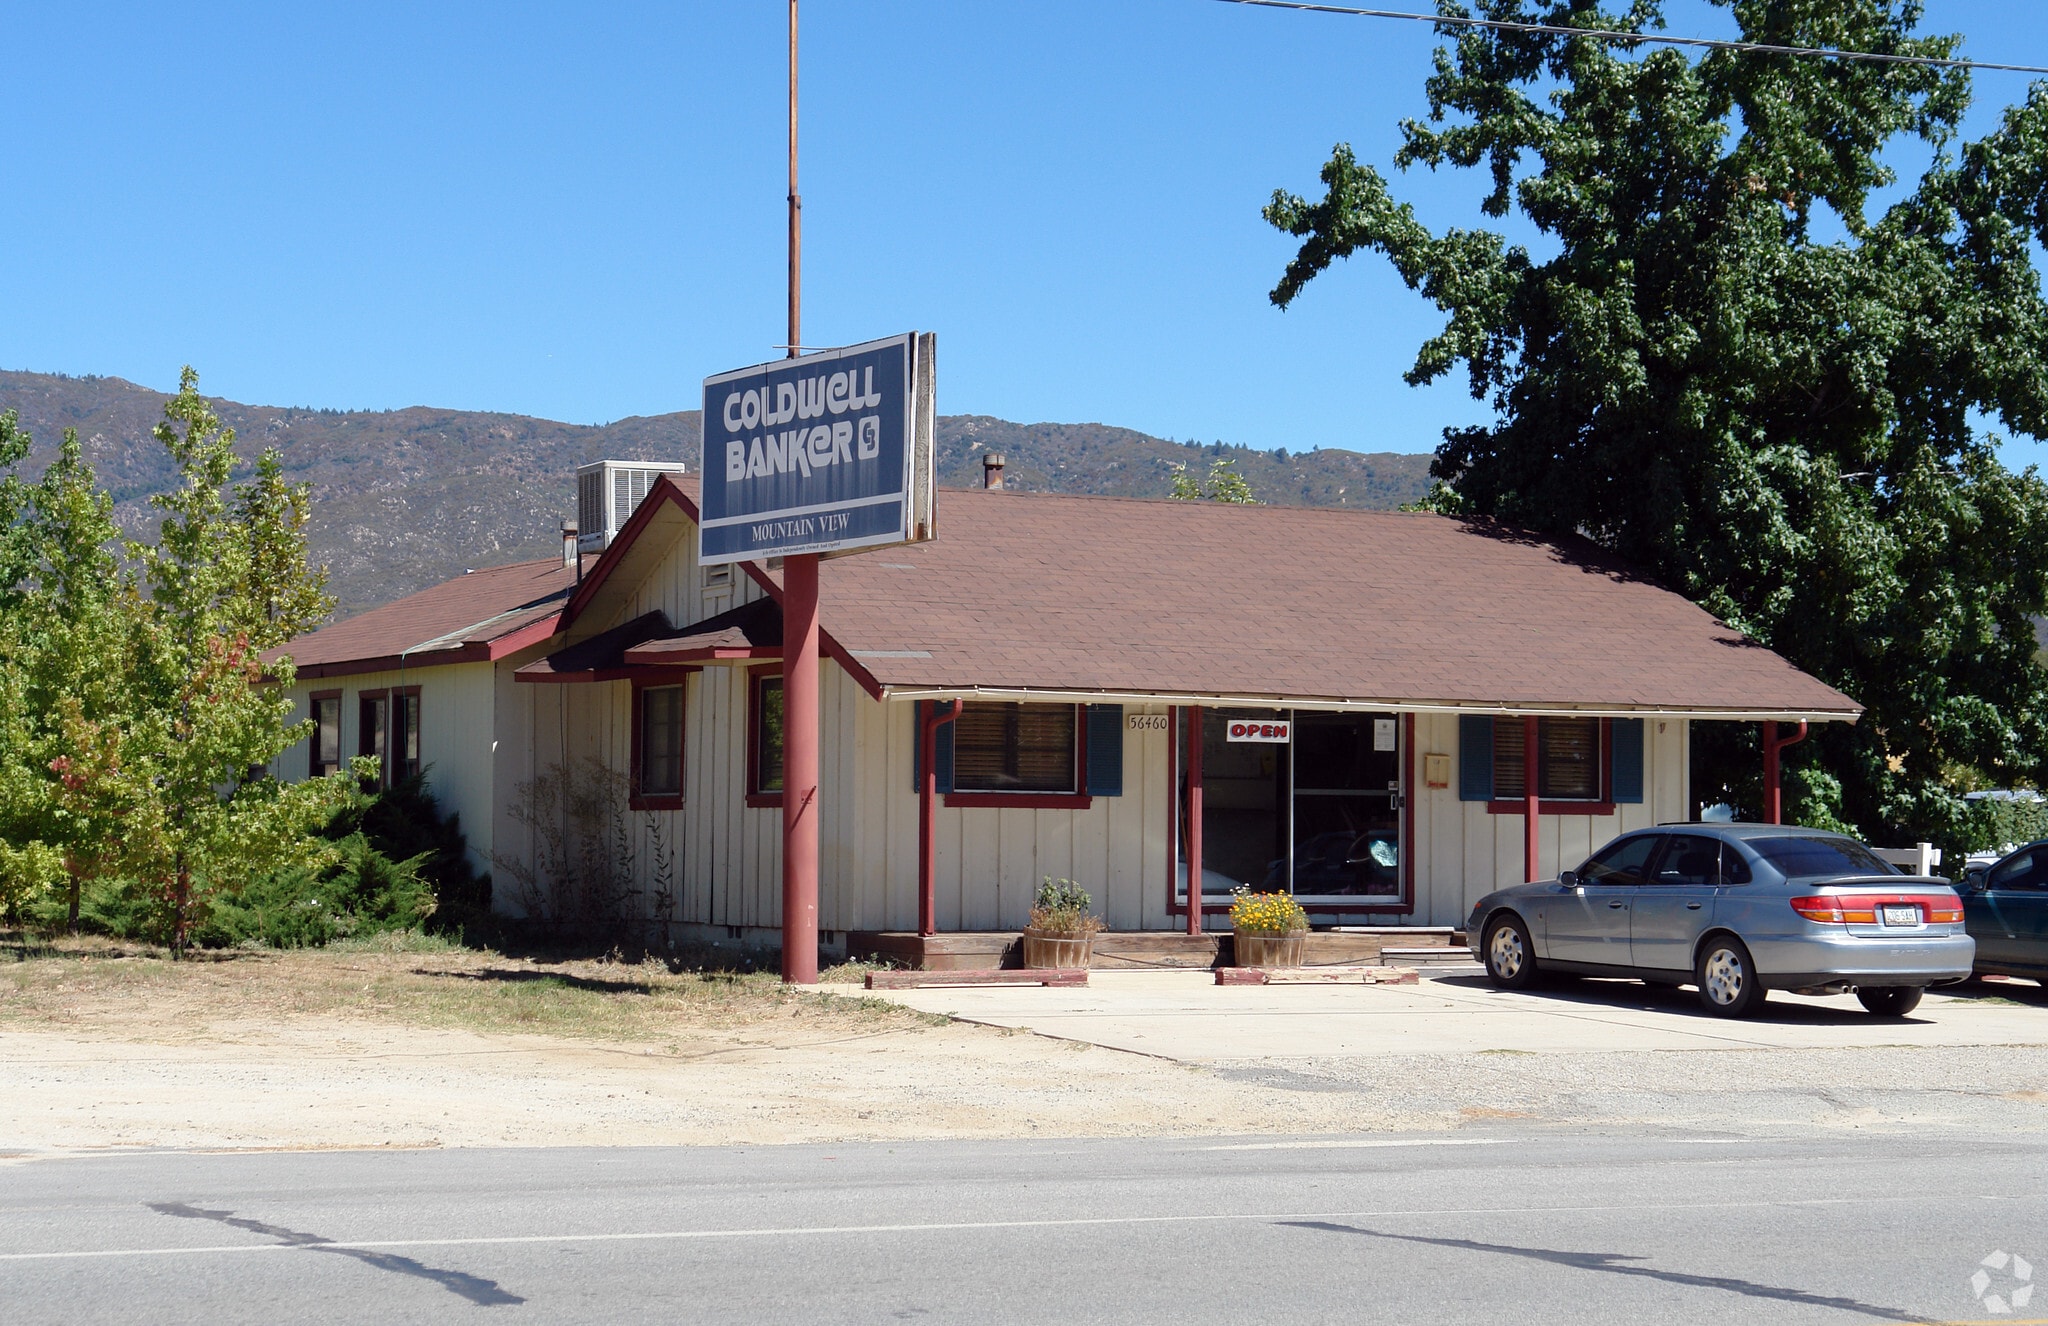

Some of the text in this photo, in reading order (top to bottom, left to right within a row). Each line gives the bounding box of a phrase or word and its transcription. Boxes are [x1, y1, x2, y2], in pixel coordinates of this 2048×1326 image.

[752, 513, 850, 542] MOUNTAIN VIEW
[1130, 717, 1167, 730] 56460
[1231, 724, 1288, 738] OPEN
